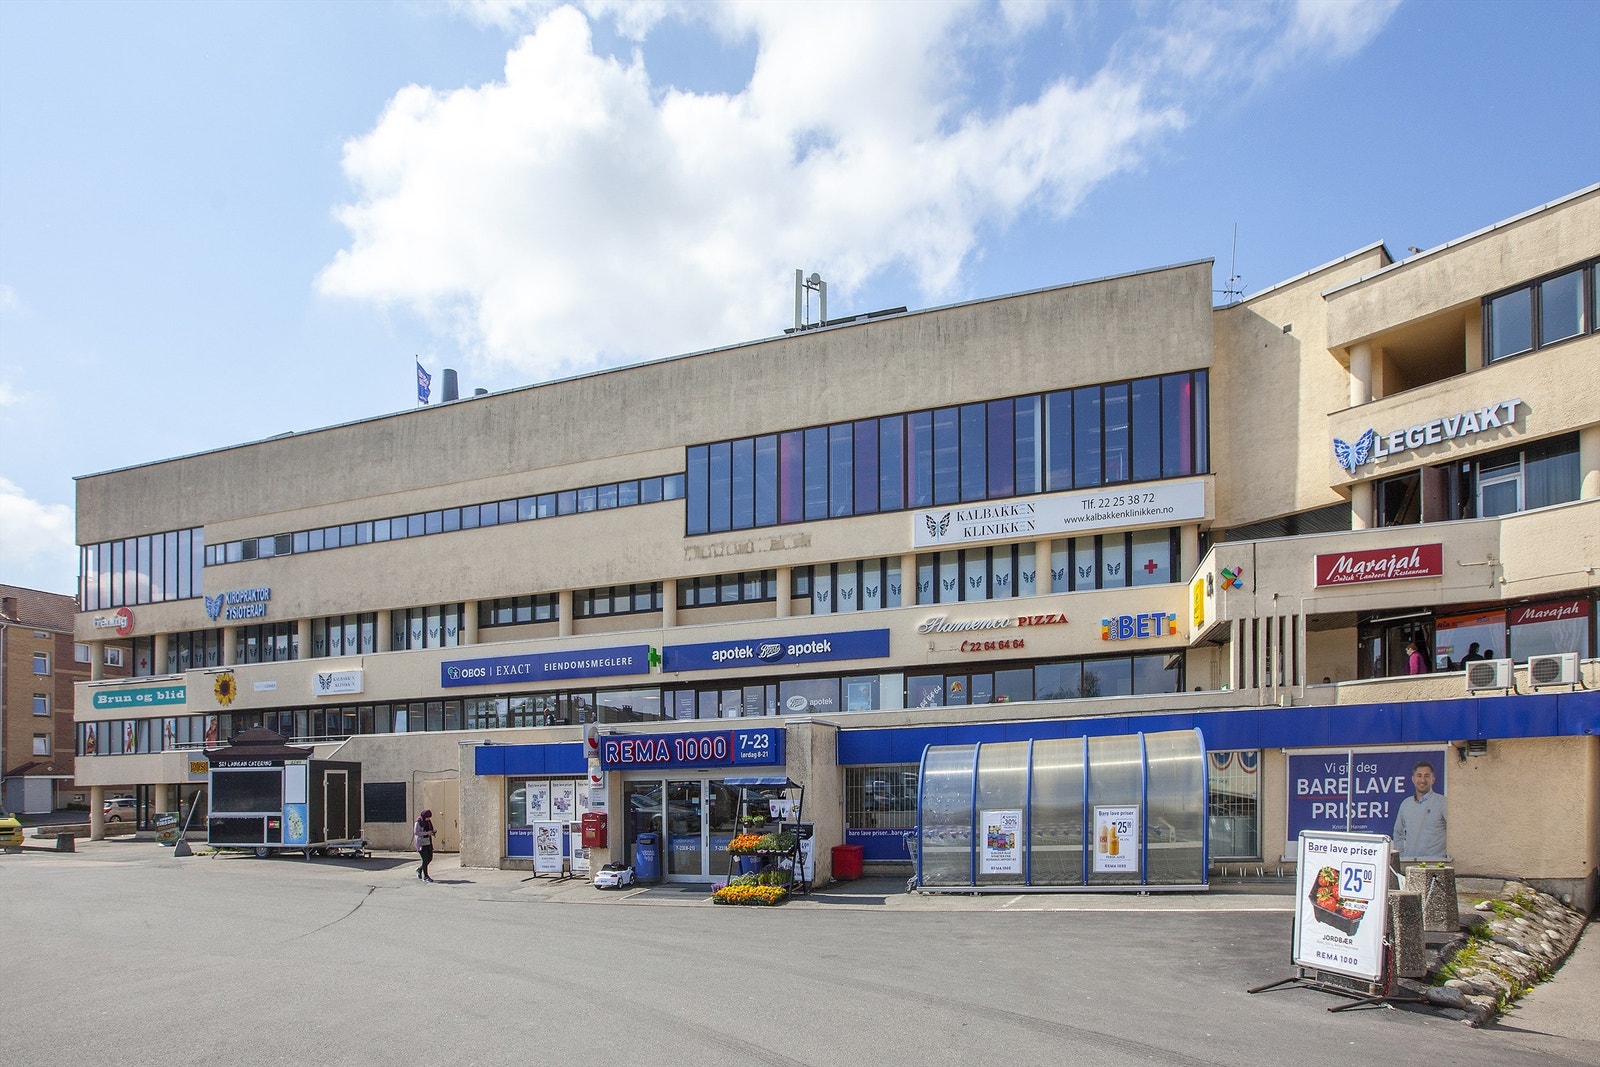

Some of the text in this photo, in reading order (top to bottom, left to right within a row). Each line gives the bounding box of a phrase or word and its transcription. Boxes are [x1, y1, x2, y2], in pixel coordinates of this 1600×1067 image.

[1374, 398, 1521, 458] LEGEVAKT
[1081, 493, 1155, 510] Tlf. 22 25 38 72
[957, 503, 1035, 521] KALBAKKEN
[1063, 506, 1174, 524] www.kalbakkenklinikken.no
[964, 520, 1035, 537] KLINIKKEN
[1326, 547, 1420, 580] Marajah
[1393, 567, 1429, 577] Restaurant
[226, 588, 271, 605] KIROPRAKTOR
[226, 604, 267, 620] FYSIOTERAPI
[1518, 601, 1579, 623] Marajah
[917, 613, 1069, 634] Flamenco PIZZA
[1119, 612, 1166, 640] BET
[712, 645, 753, 662] apotek
[788, 639, 832, 657] apotek
[970, 638, 1025, 652] 22 64 64 64
[461, 656, 633, 678] OBOS EXACT EIENDOMSMEGLERE
[97, 690, 184, 704] Brun og blid
[809, 697, 833, 706] apotek
[605, 735, 727, 763] REMA 1000
[739, 734, 769, 749] 7-23
[1324, 762, 1377, 775] Vi gi deg
[1297, 776, 1405, 795] BARE LAVE
[1312, 801, 1389, 819] PRISER!
[1117, 821, 1128, 833] 25
[1308, 842, 1378, 856] Bare lave priser
[1343, 867, 1363, 893] 25
[1322, 934, 1353, 945] JORDBÆR
[1316, 950, 1358, 965] REMA 1000
